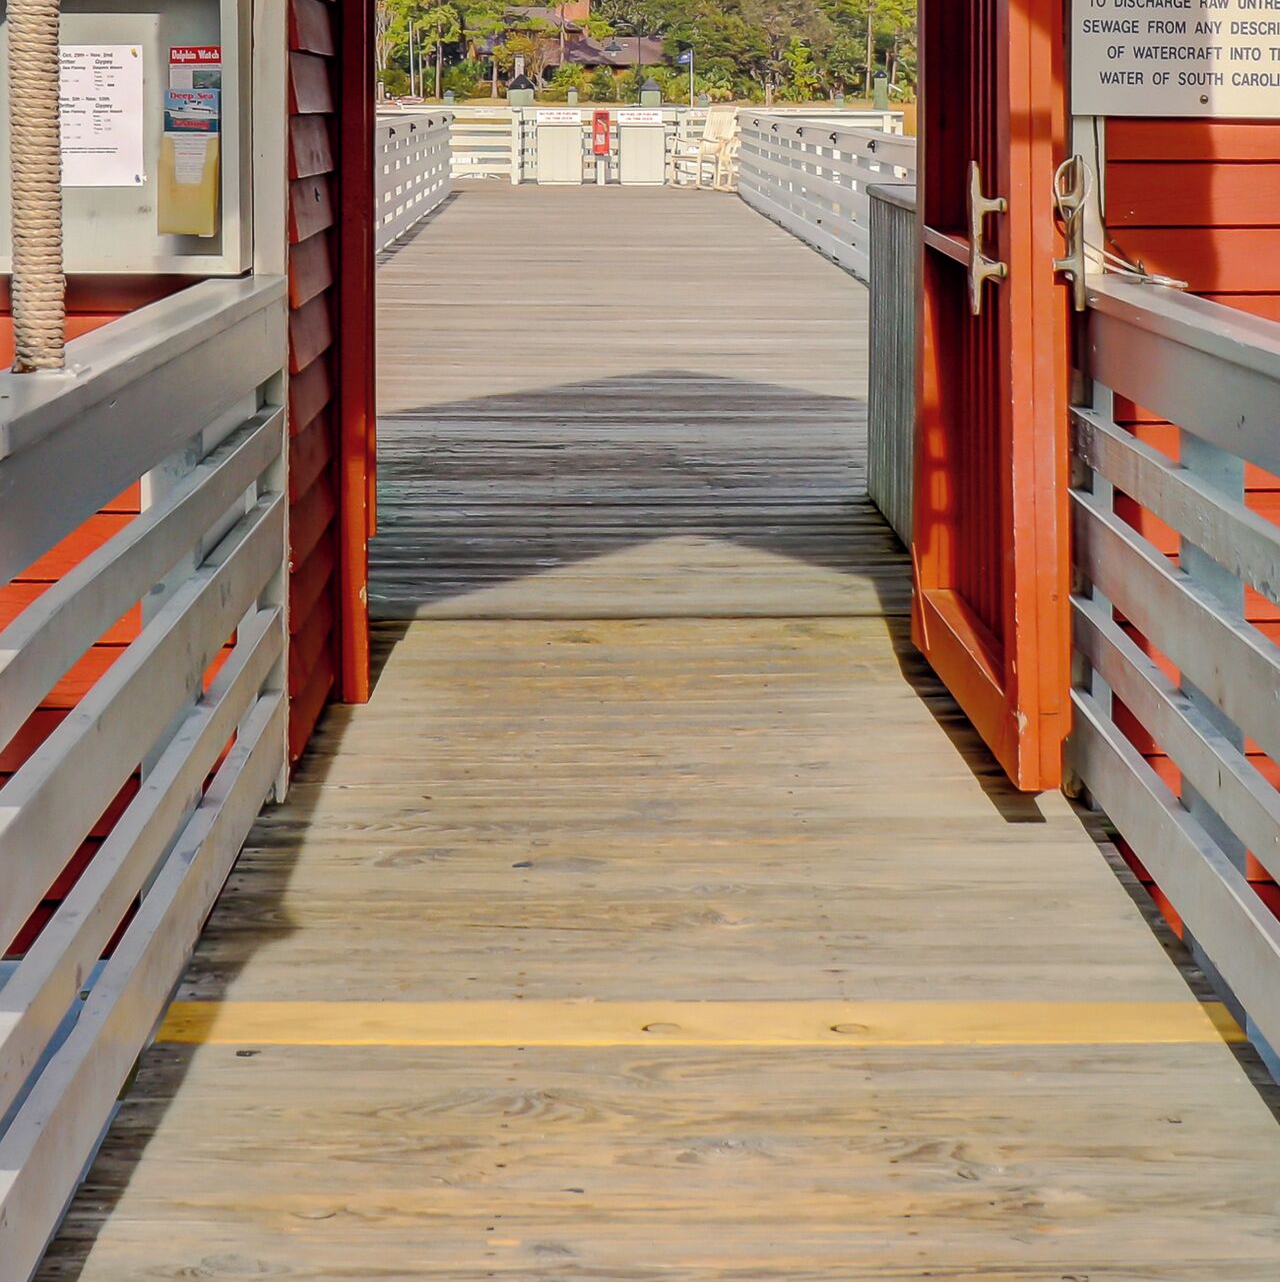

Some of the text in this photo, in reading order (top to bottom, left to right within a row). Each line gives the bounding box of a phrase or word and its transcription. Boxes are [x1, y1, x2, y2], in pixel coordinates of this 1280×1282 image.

[1082, 20, 1140, 34] SEWAGE
[1147, 21, 1187, 34] FROM
[1194, 21, 1222, 35] ANY
[1107, 46, 1125, 60] OF
[1133, 46, 1222, 61] WATERCRAFT
[1230, 47, 1262, 61] INTO
[1099, 72, 1144, 85] WATER
[1152, 72, 1171, 86] OF
[1178, 72, 1224, 86] SOUTH
